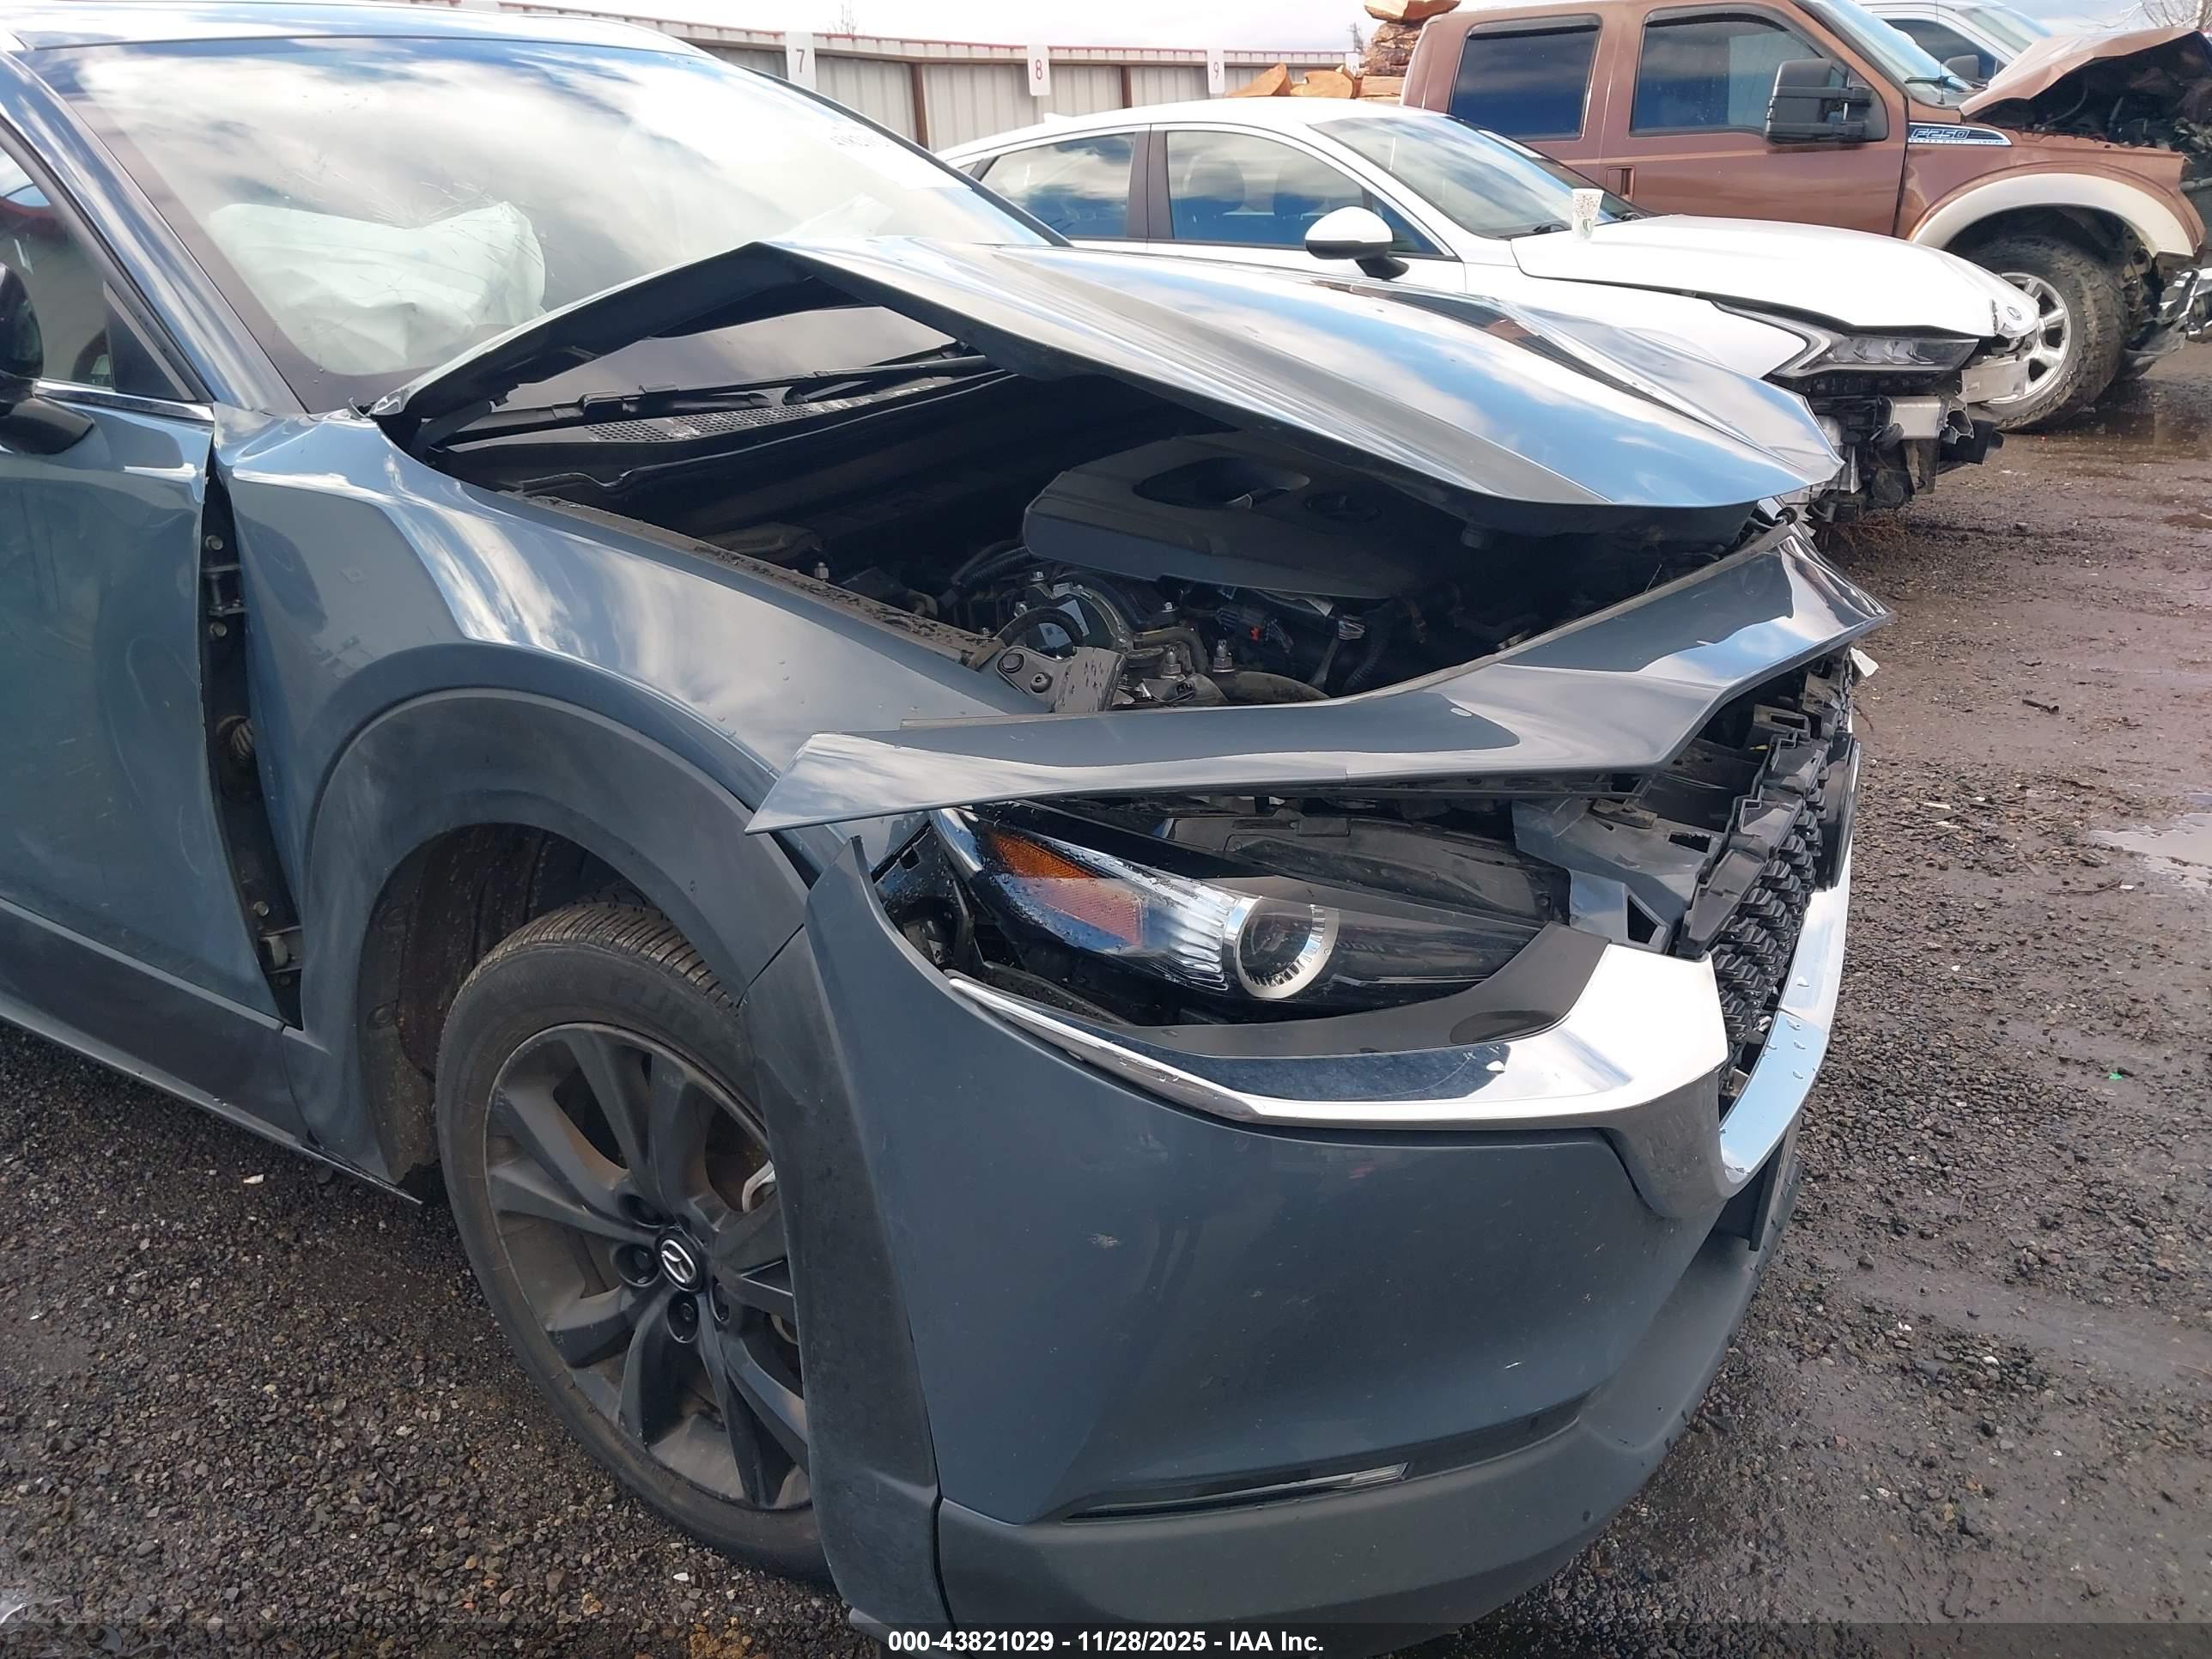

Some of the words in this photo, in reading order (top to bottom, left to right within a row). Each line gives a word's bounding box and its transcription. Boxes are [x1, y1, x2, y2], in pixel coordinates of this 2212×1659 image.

[795, 48, 805, 73] 7
[1035, 59, 1043, 81] 8
[1212, 61, 1220, 80] 9
